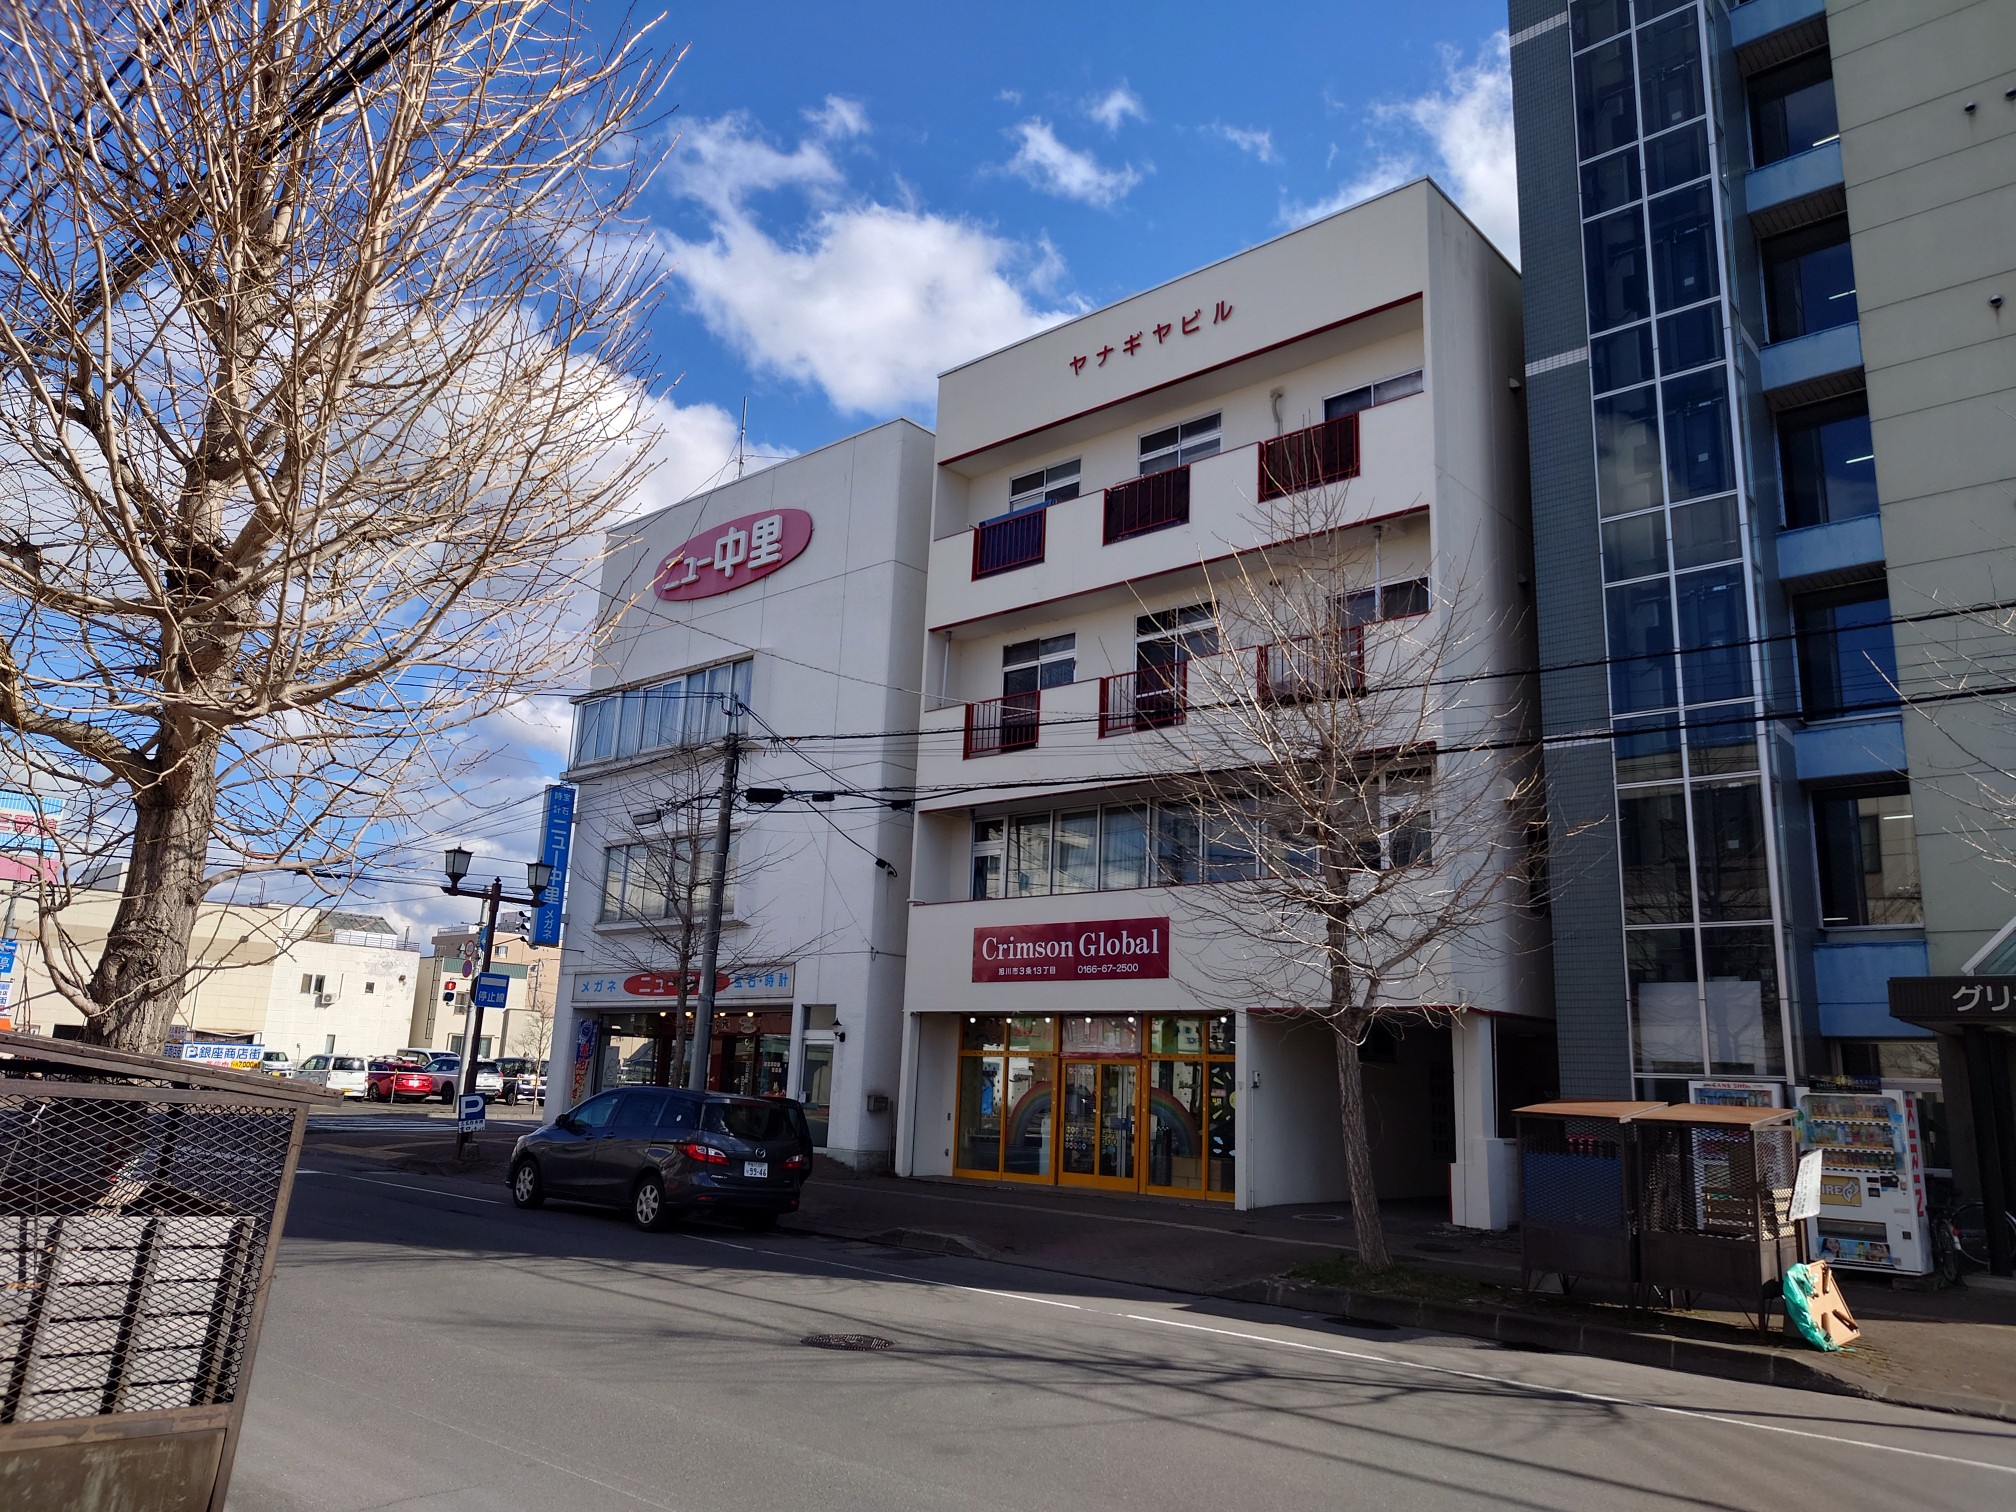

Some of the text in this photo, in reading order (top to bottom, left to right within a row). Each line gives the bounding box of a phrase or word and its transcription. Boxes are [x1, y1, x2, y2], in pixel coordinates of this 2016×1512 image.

[1069, 300, 1233, 376] ヤナギヤビル
[662, 514, 783, 591] ニュー中里
[543, 819, 567, 905] ニュー中里
[543, 909, 554, 939] メガネ
[982, 928, 1160, 961] Crimson Global
[1077, 963, 1139, 974] 0166-67-2500
[478, 990, 505, 1003] 停止線
[581, 980, 617, 993] メガネ
[1952, 984, 2016, 1012] グリ
[199, 1046, 261, 1060] 銀座商店街
[460, 1095, 484, 1119] P
[749, 1167, 767, 1177] 99-46
[1821, 1184, 1843, 1195] IRE
